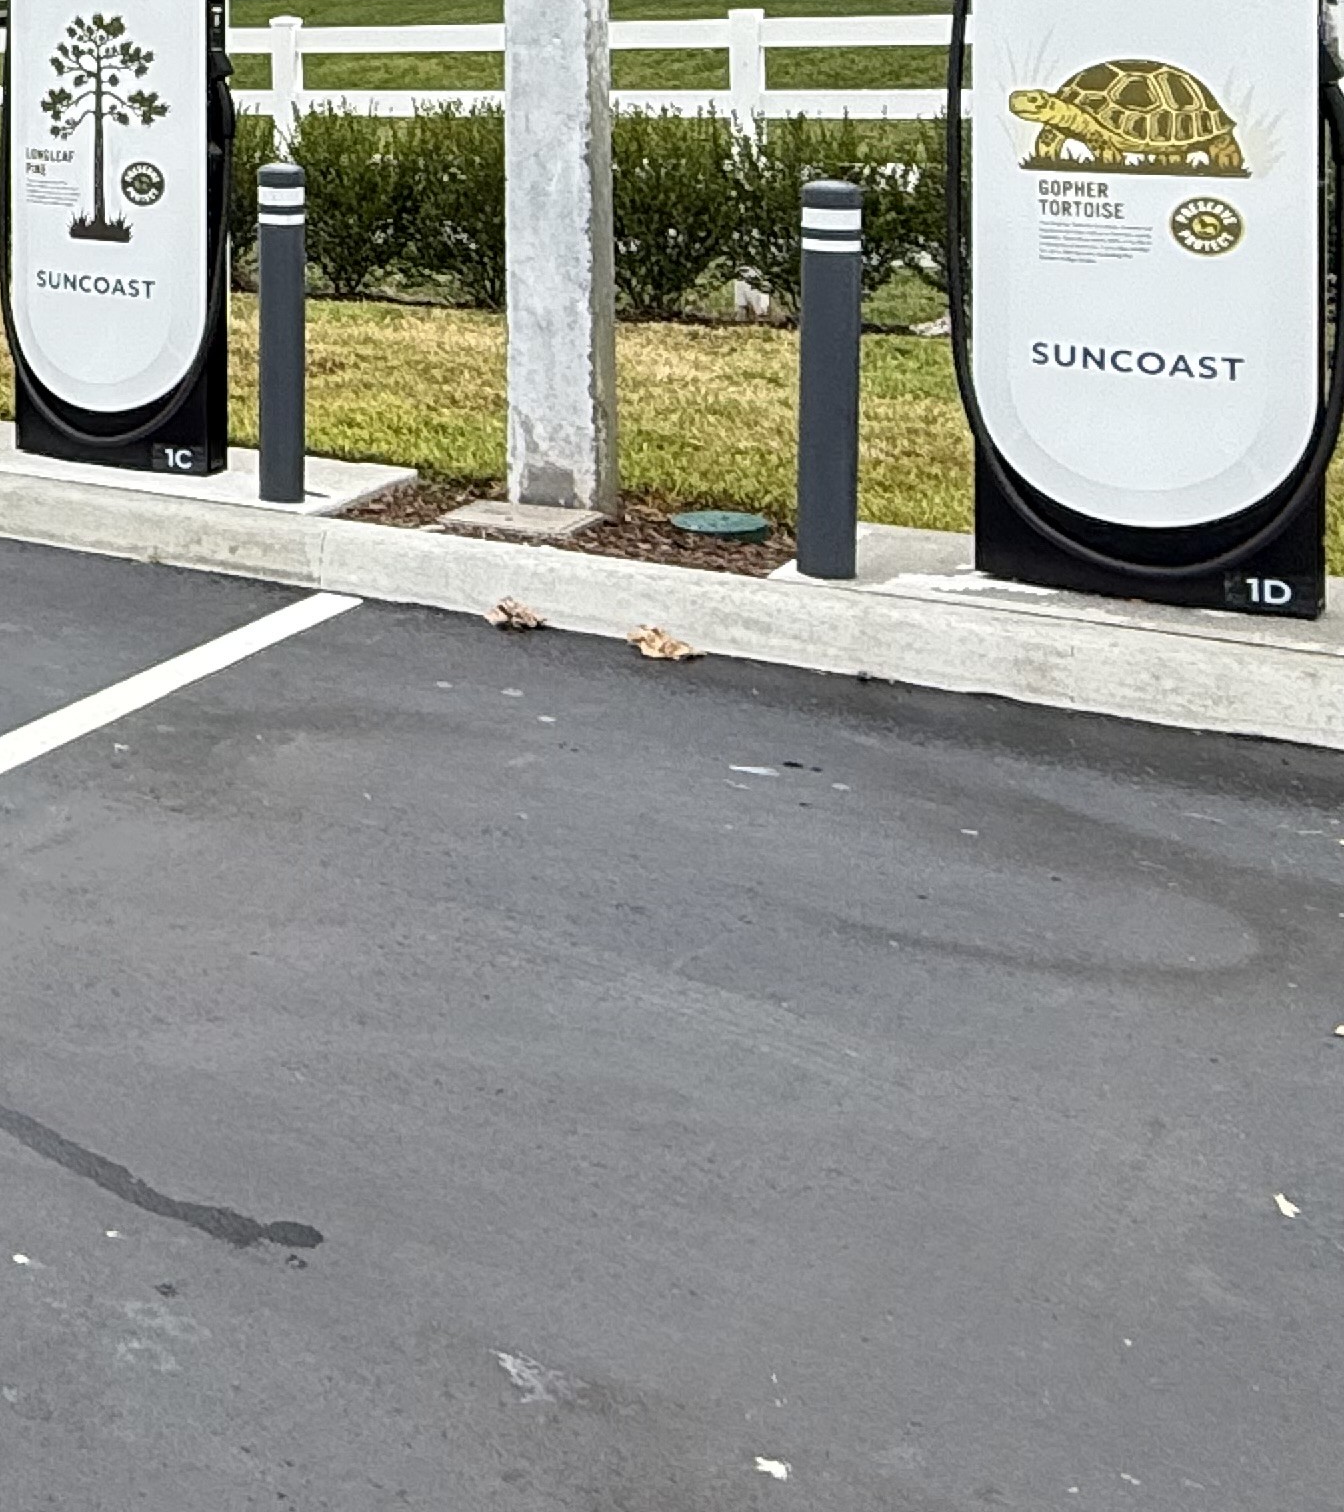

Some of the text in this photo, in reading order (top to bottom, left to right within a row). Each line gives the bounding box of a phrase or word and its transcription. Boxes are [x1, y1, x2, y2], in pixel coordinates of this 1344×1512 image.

[1038, 179, 1109, 199] GOPHER
[1038, 198, 1126, 220] TORTOISE
[36, 269, 156, 299] SUNCOAST
[1032, 341, 1246, 382] SUNCOAST
[164, 448, 193, 470] 1C
[1245, 577, 1292, 605] 1D
